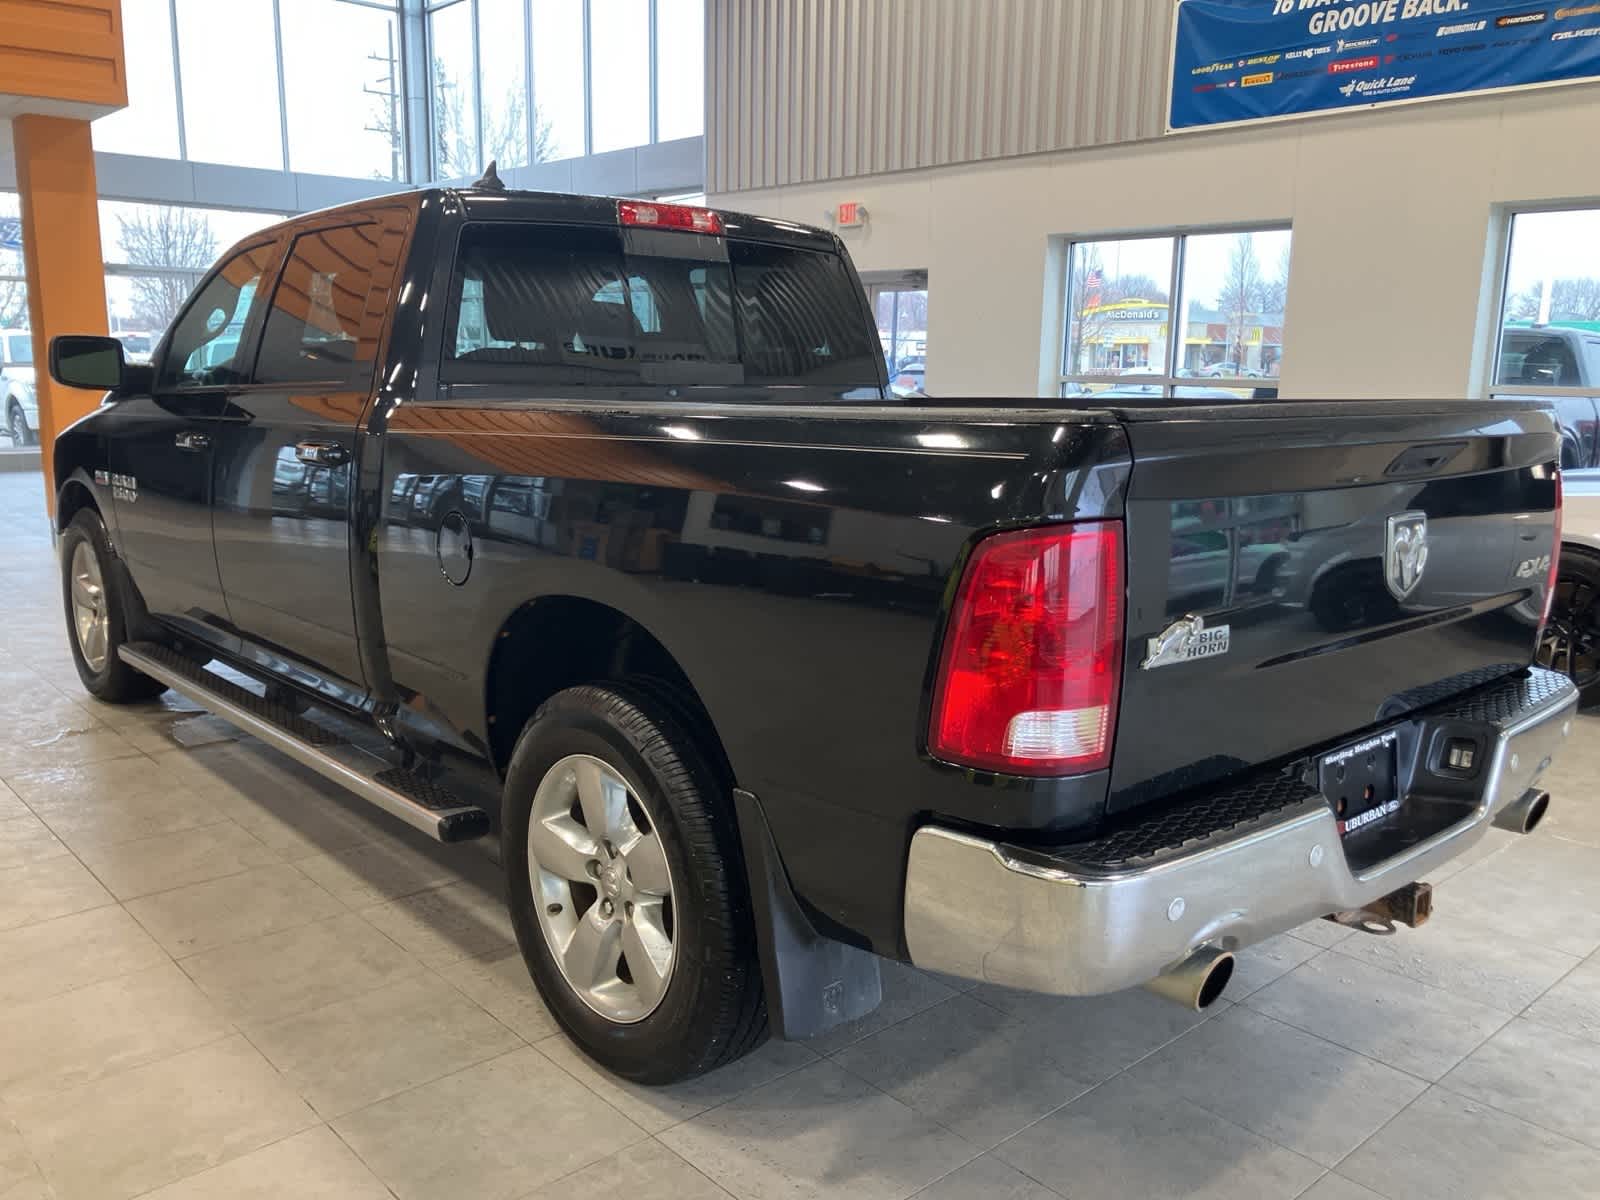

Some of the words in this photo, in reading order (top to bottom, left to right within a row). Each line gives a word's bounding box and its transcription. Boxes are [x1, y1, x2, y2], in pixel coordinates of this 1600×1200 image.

[1308, 0, 1399, 35] GROOVE
[1191, 62, 1234, 75] GOODYEAR
[1333, 60, 1374, 72] Firestone
[1355, 79, 1387, 92] Quick
[1387, 76, 1416, 87] Lane
[1105, 309, 1160, 321] McDonald's
[1199, 630, 1224, 647] BIG
[1187, 641, 1228, 658] HORN
[1325, 749, 1354, 765] Sterling
[1355, 739, 1380, 752] Heights
[1381, 731, 1396, 743] Ford
[1337, 803, 1387, 833] UBURBAN
